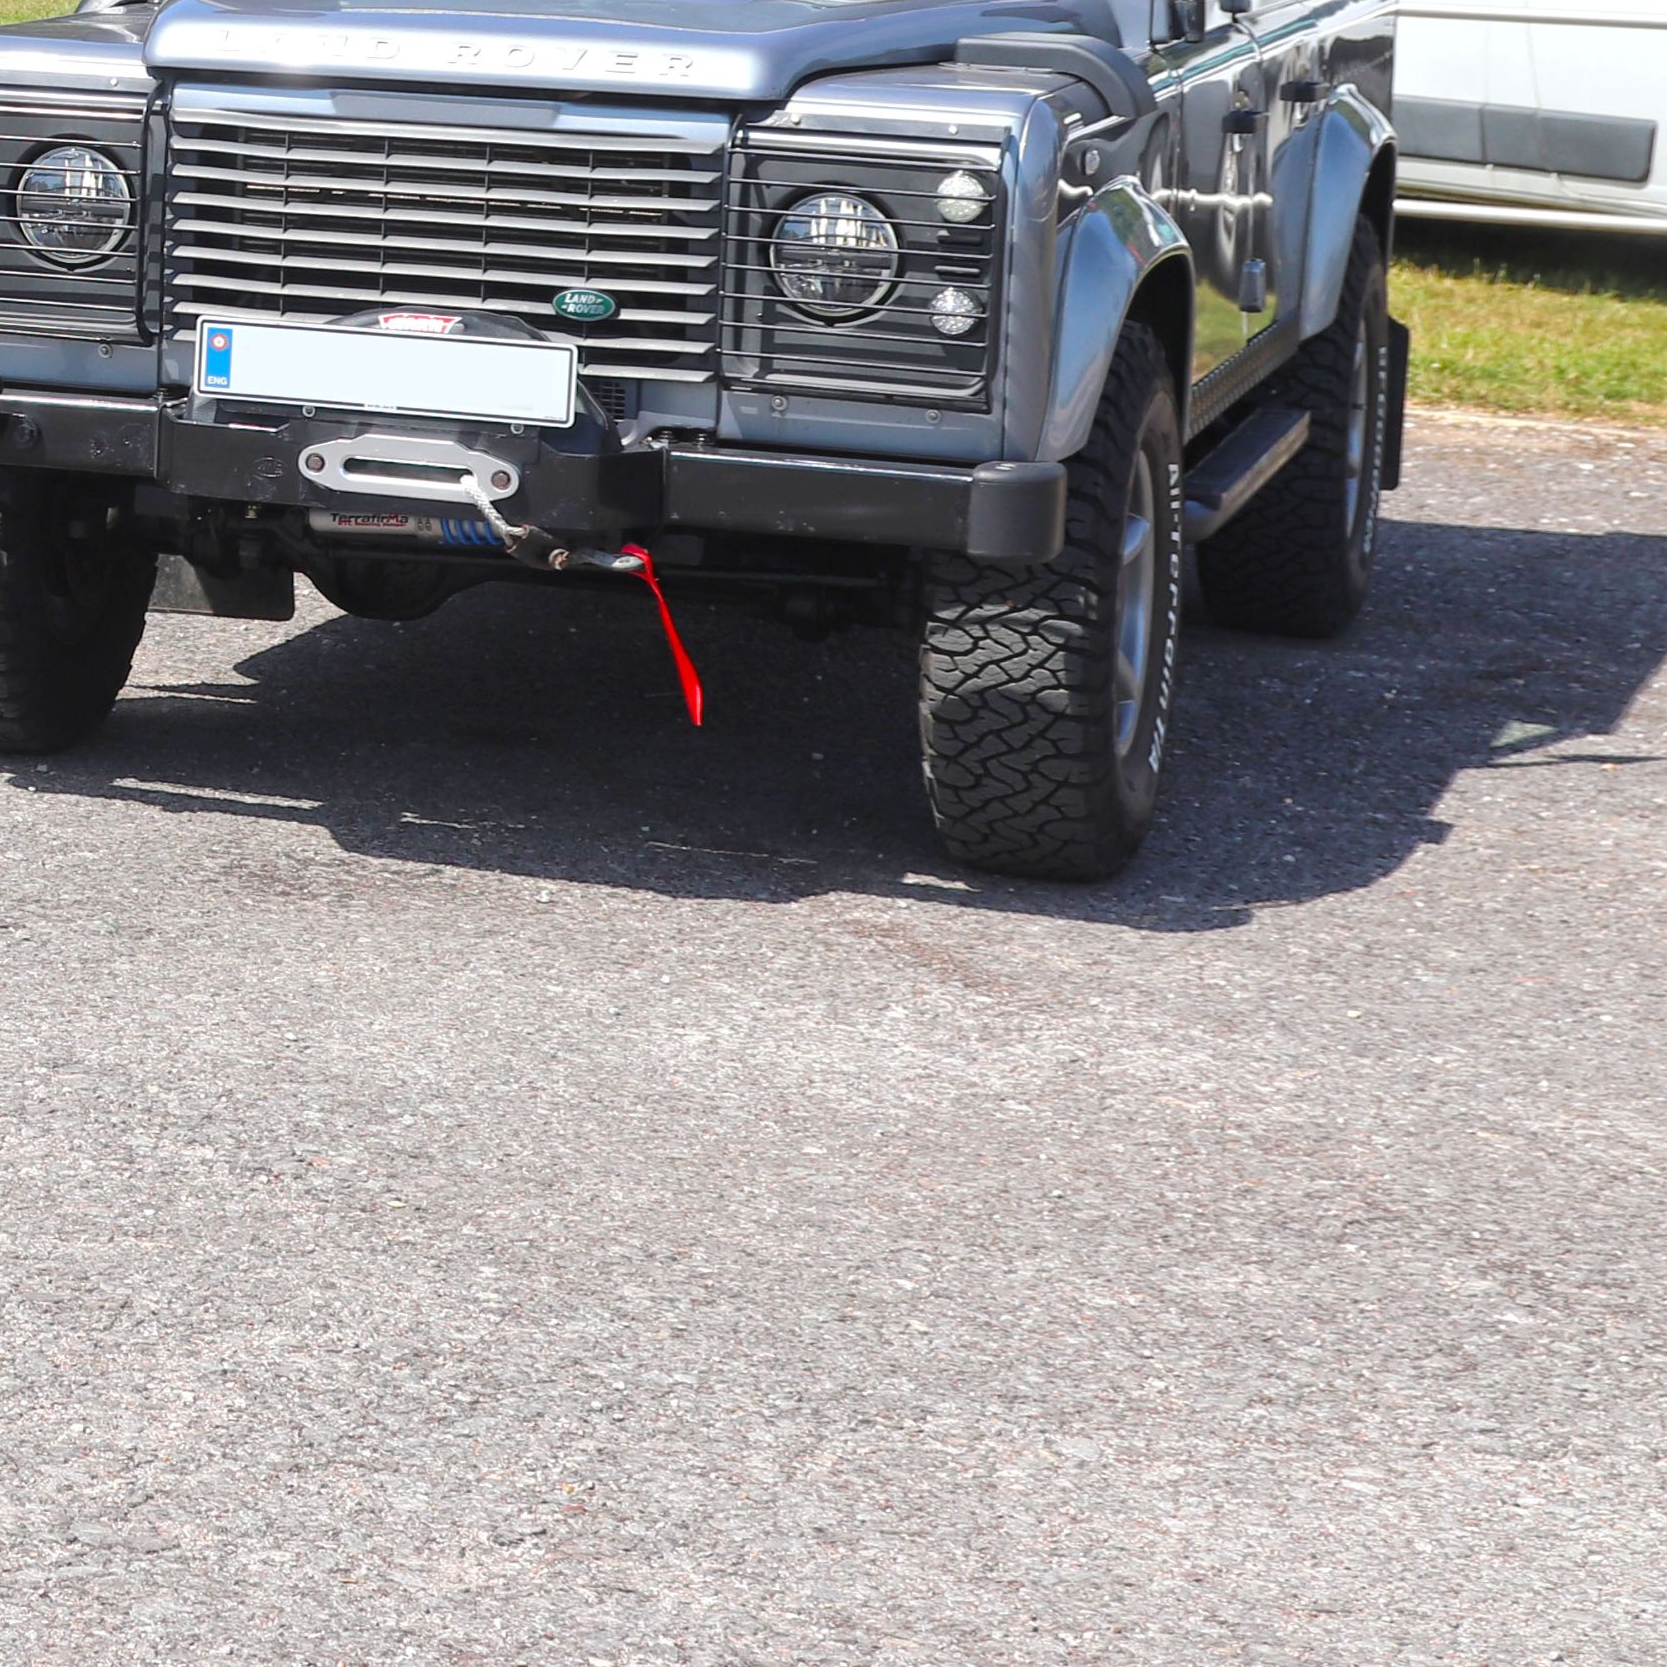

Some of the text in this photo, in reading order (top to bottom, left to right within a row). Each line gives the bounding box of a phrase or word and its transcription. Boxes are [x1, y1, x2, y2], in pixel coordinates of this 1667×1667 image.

[447, 42, 695, 77] ROVER
[565, 292, 596, 304] LAND
[567, 303, 605, 315] ROVER
